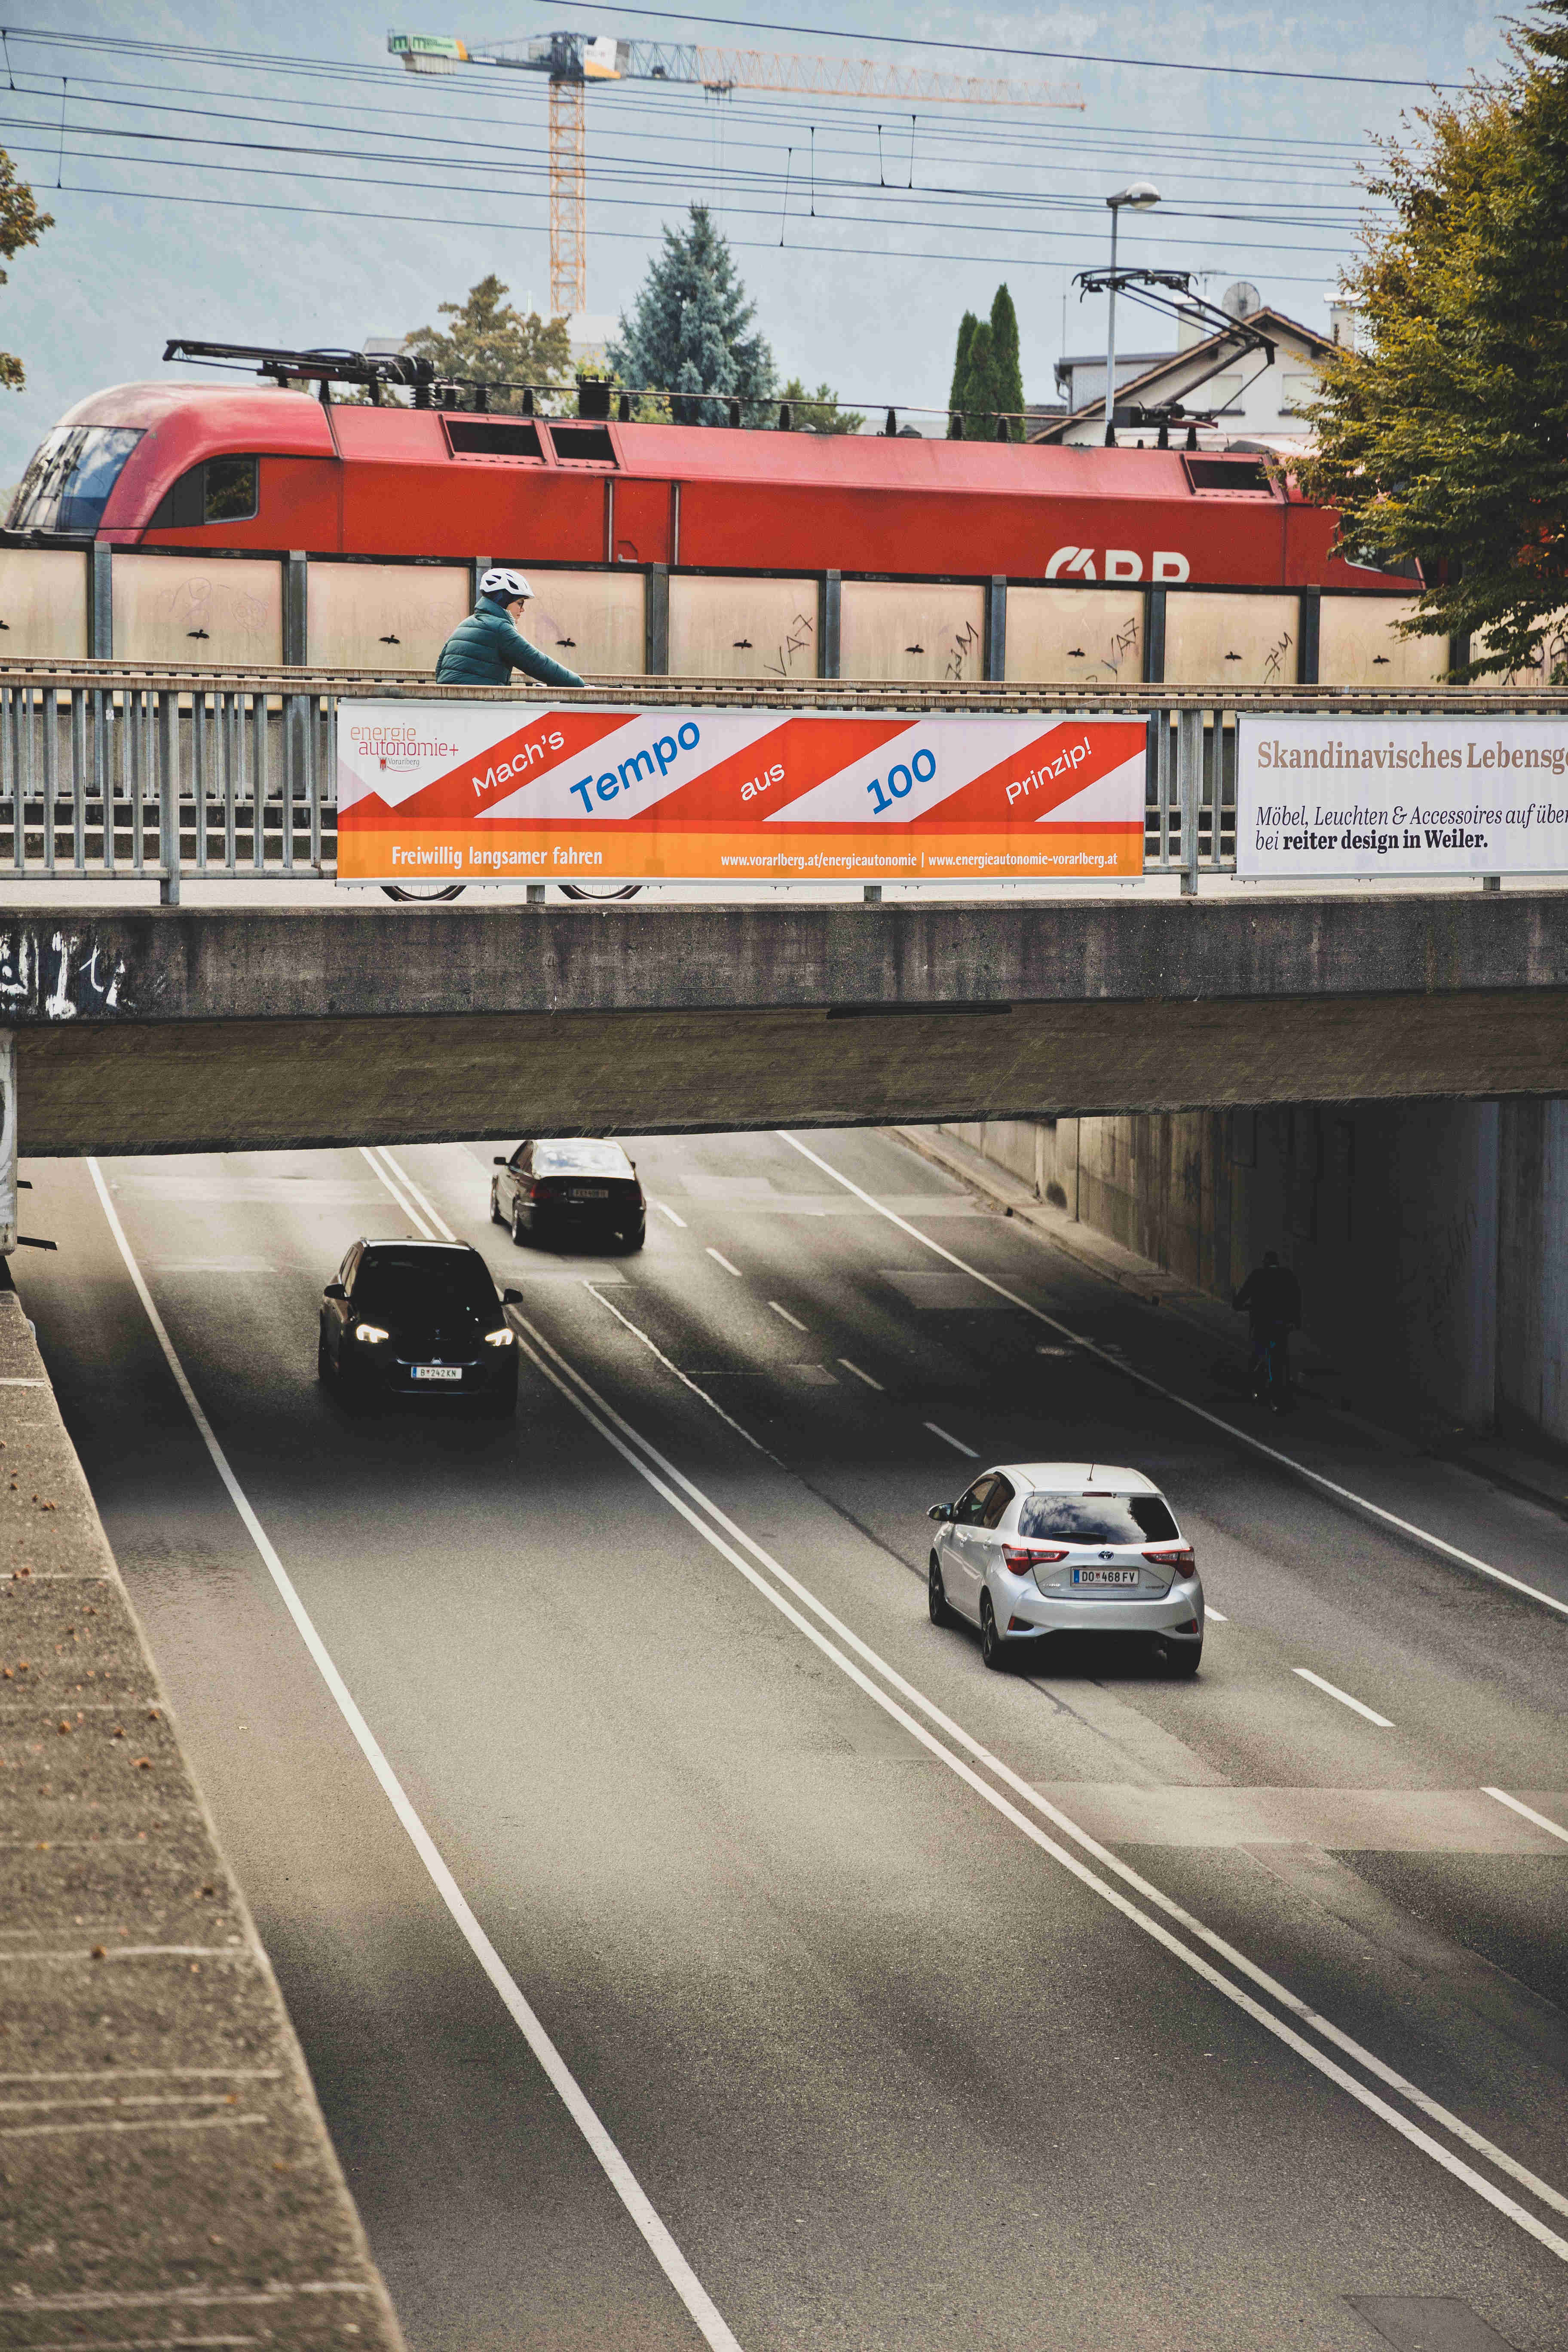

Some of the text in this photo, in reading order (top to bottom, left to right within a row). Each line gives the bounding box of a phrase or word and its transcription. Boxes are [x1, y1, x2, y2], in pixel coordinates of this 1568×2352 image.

[350, 723, 416, 741] energie
[359, 738, 459, 756] autonomie+
[1258, 740, 1568, 775] Skandinavisches Lebensg
[388, 756, 420, 767] Vorarlberg
[472, 722, 1092, 815] Mach's Tempo aus 100 Prinzip!
[1256, 805, 1309, 829] Möbel,
[1314, 805, 1389, 825] Leuchten
[1393, 806, 1408, 825] &
[1410, 805, 1502, 825] Accessoires
[1505, 803, 1535, 829] auf
[1256, 829, 1488, 854] bei reiter design in Weiler.
[392, 846, 602, 870] Freiwillig langsamer fahren
[721, 851, 917, 869] www.vorarlberg.at/energieautonomie
[928, 852, 1118, 869] www.energieautonomie-vorarlberg.at
